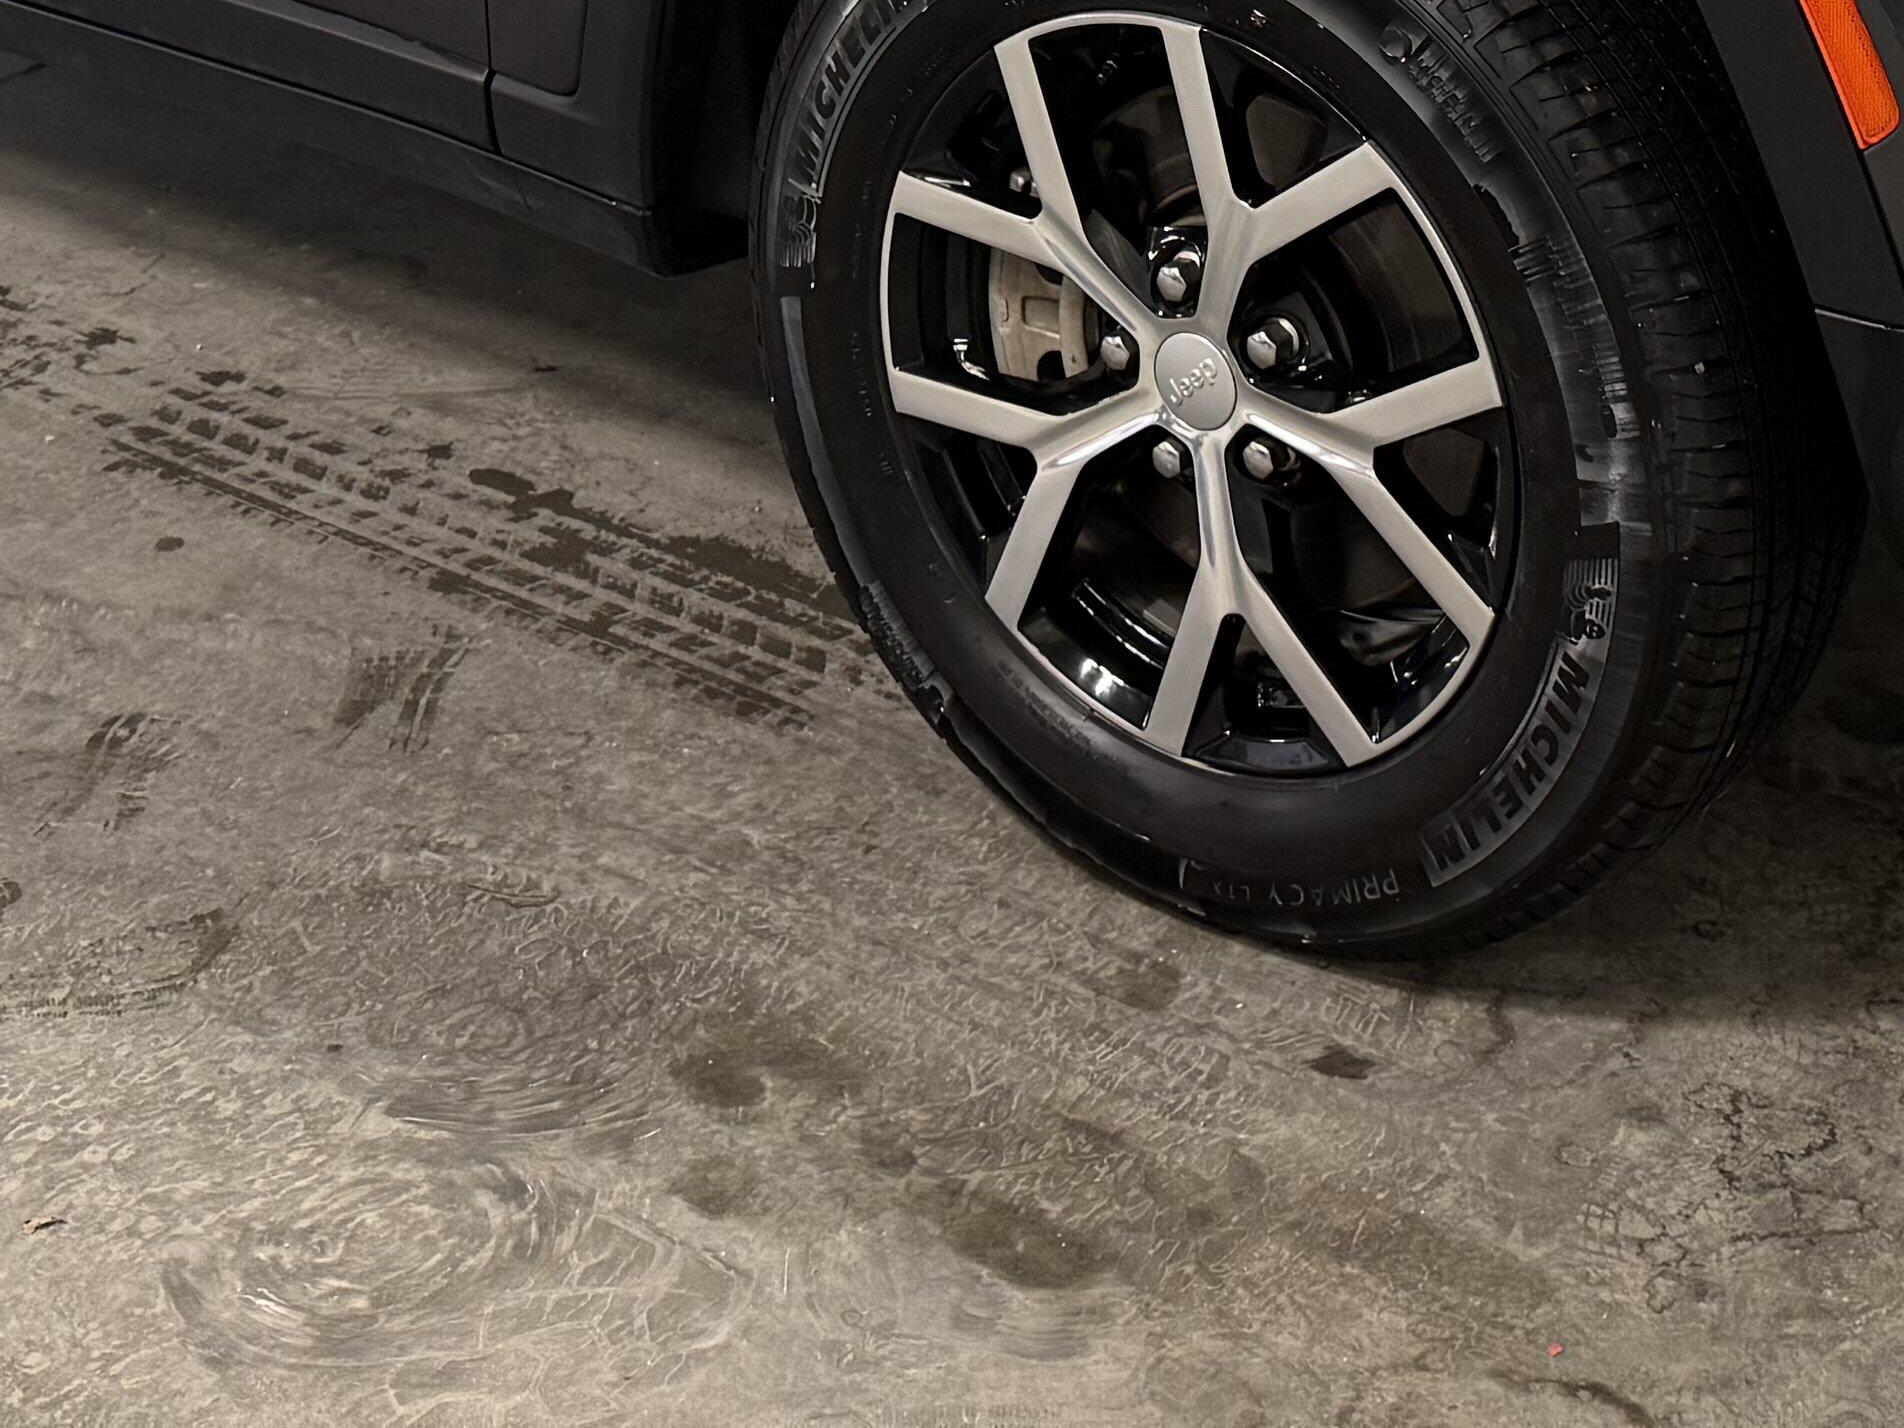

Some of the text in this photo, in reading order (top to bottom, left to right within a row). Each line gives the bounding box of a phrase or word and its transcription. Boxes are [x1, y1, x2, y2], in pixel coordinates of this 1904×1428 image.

[1169, 357, 1218, 406] Jeep
[1424, 649, 1592, 872] MICHELIN
[1268, 867, 1401, 907] PRIMACY
